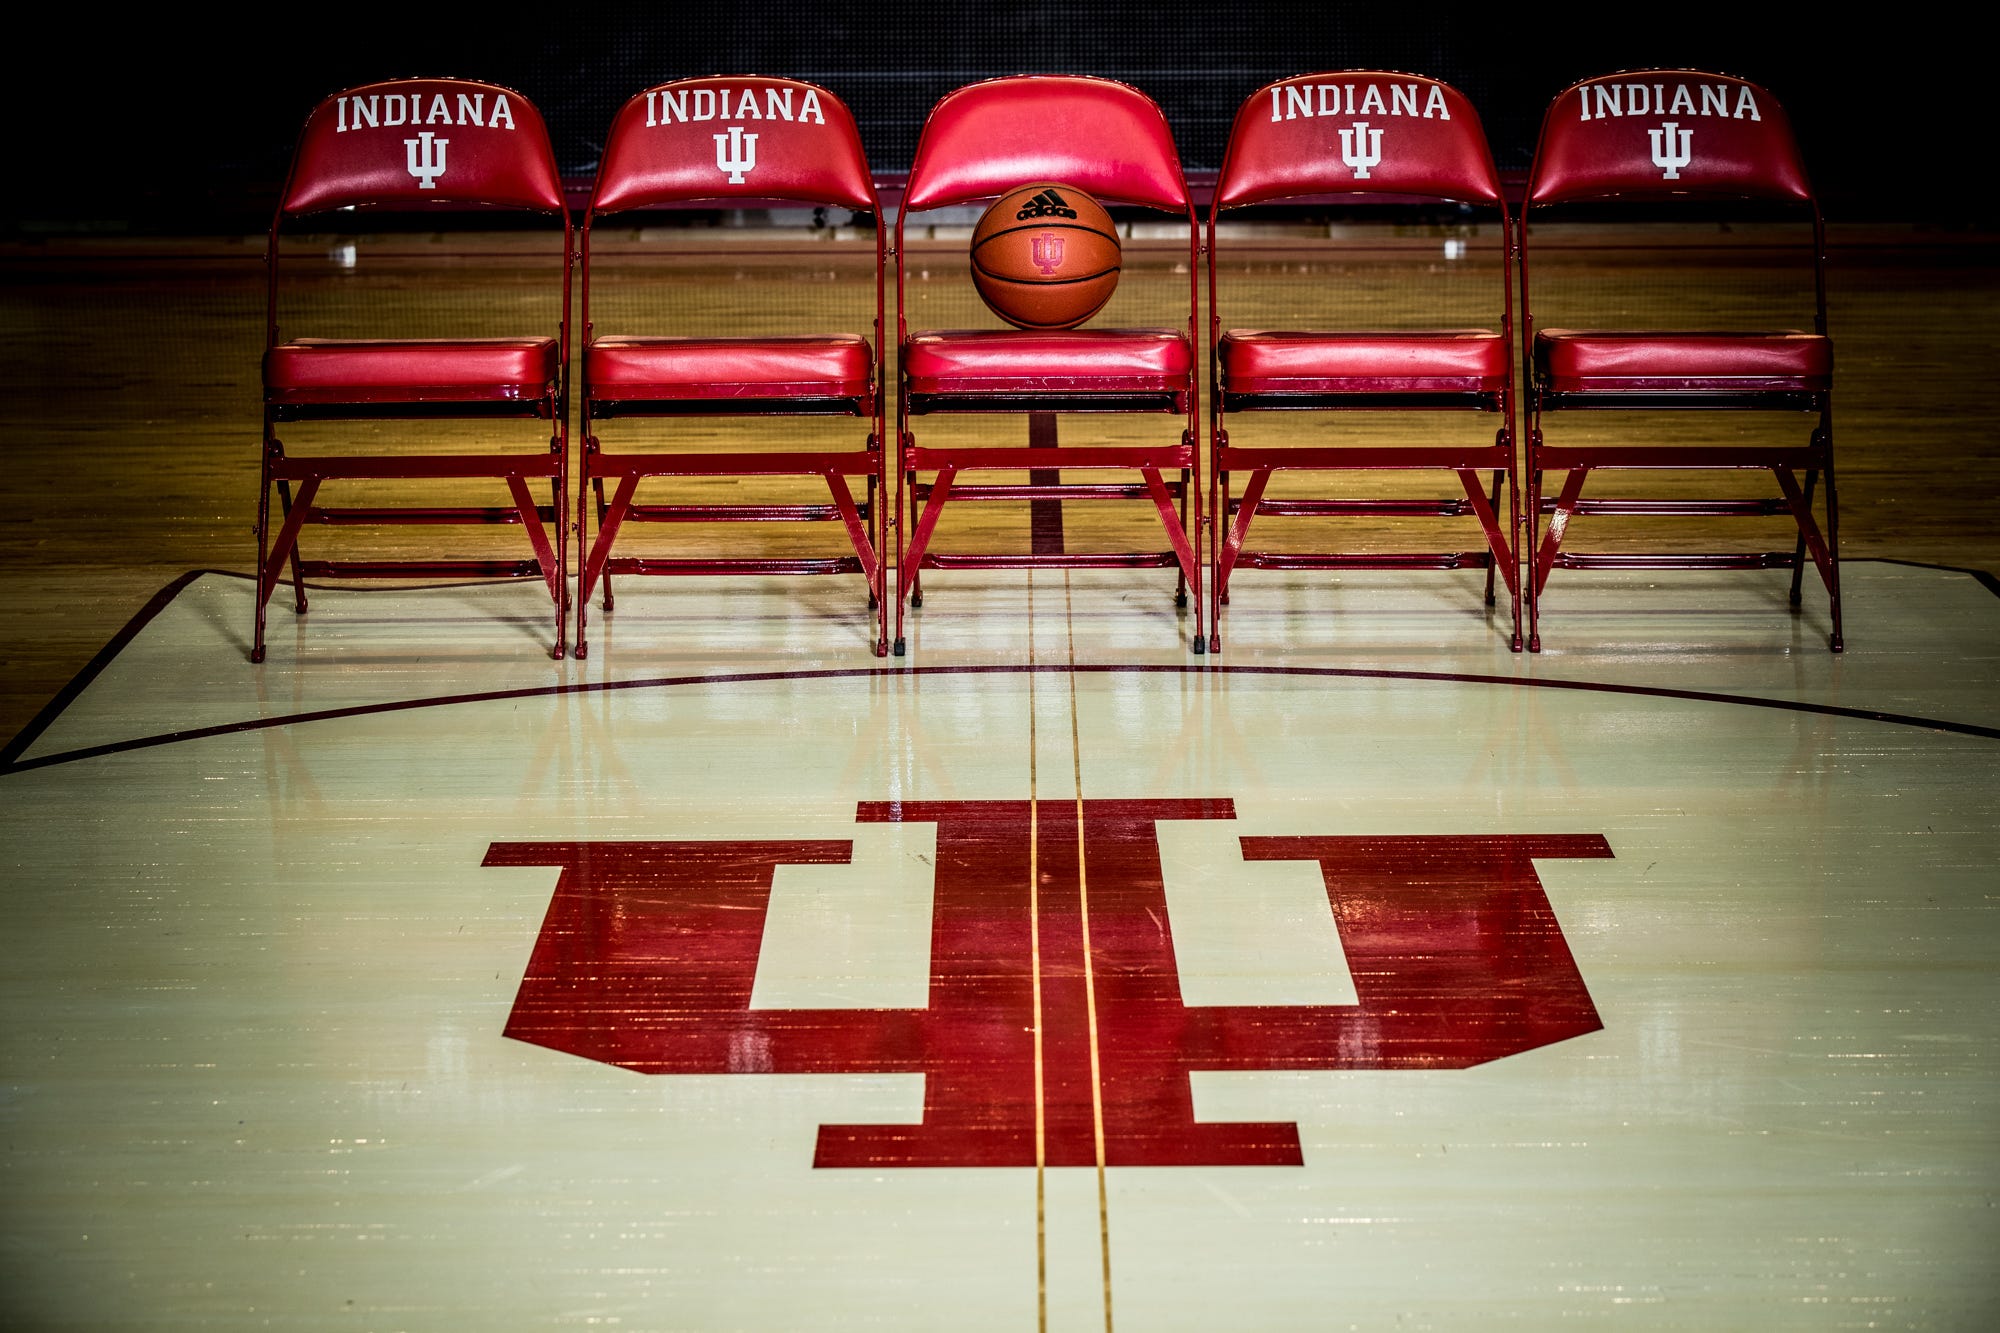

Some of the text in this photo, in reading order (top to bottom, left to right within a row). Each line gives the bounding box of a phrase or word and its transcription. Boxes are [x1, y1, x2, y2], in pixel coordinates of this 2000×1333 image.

[336, 93, 516, 133] INDIANA
[645, 88, 825, 128] INDIANA
[1270, 84, 1451, 123] INDIANA
[1578, 84, 1762, 122] INDIANA
[1016, 205, 1078, 221] adidas
